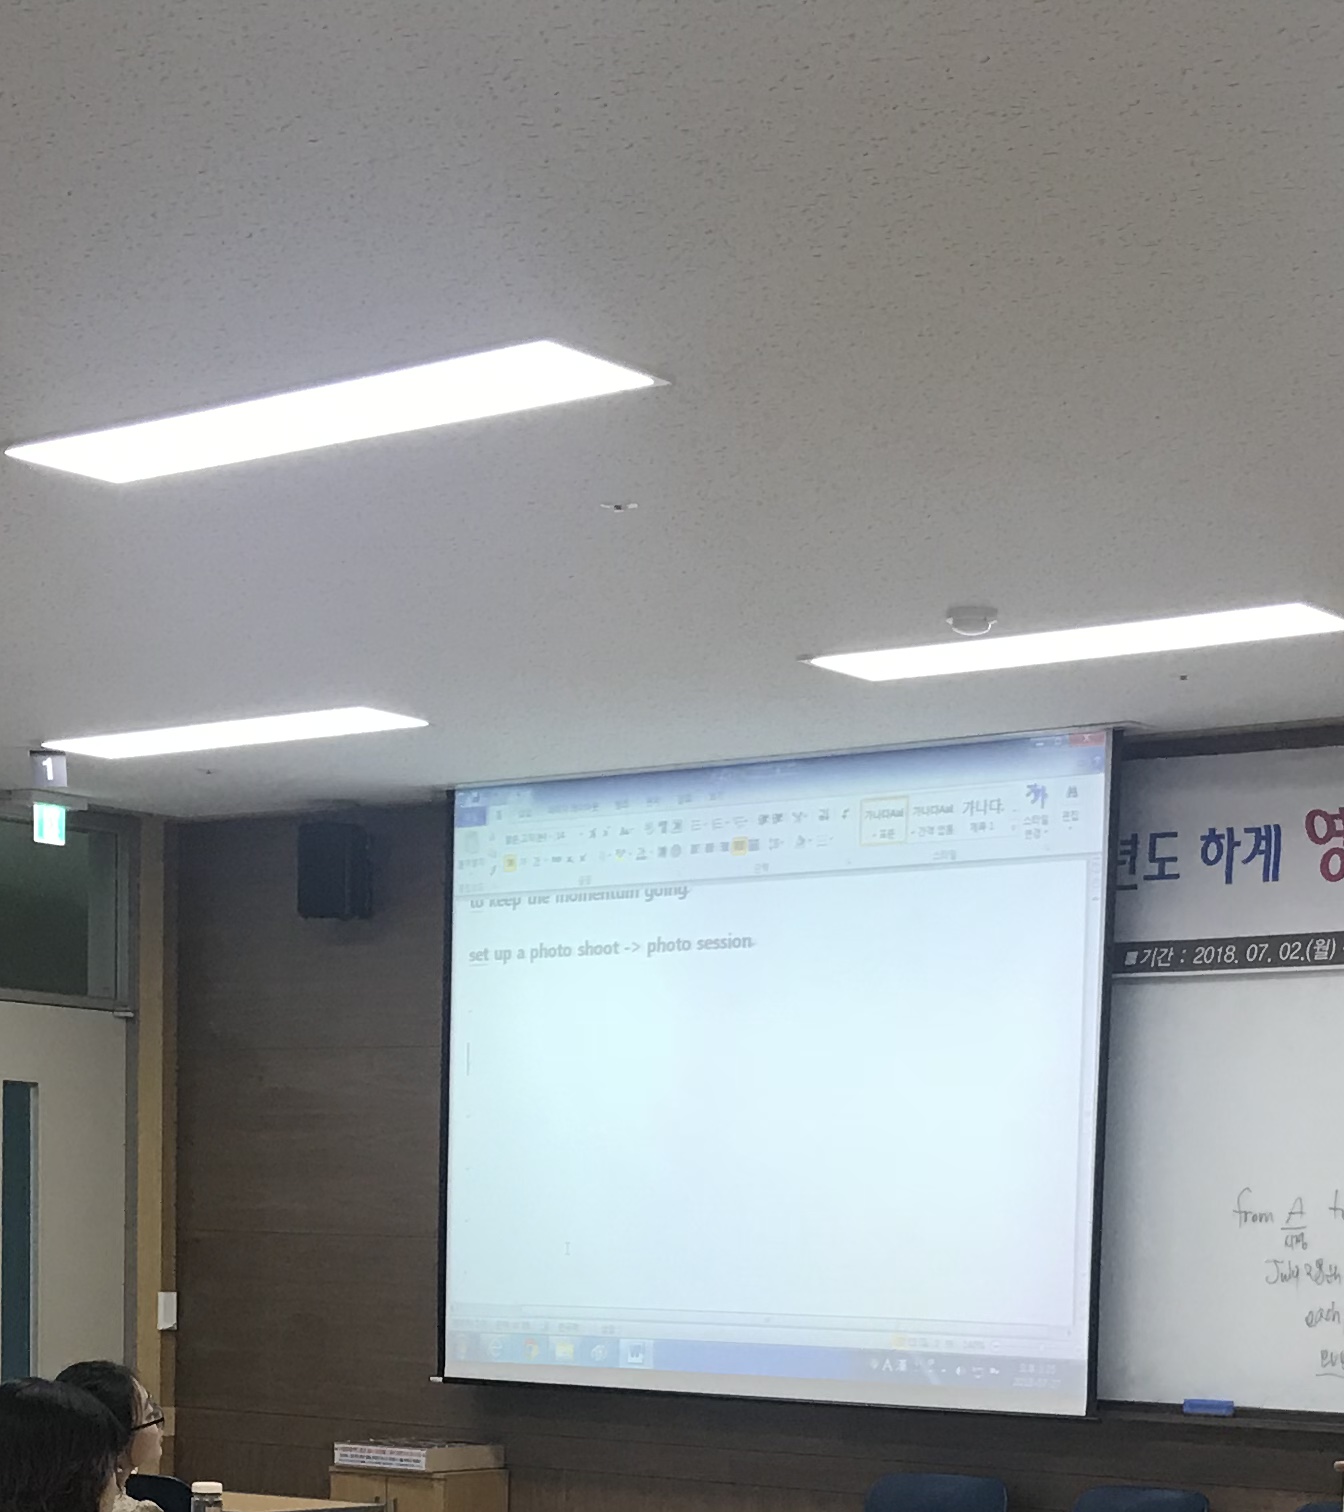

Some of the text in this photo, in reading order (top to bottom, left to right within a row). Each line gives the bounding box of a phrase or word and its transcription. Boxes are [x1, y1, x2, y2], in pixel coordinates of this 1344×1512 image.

[42, 757, 54, 781] 1
[1200, 823, 1282, 885] 하계
[468, 948, 489, 963] set
[494, 947, 512, 966] up
[516, 948, 525, 960] a
[529, 942, 573, 964] photo
[577, 939, 620, 958] shoot
[646, 936, 692, 958] photo
[1140, 946, 1175, 968] 기간
[1193, 945, 1239, 965] 2018.
[1246, 943, 1273, 964] 07.
[1232, 1187, 1274, 1228] from
